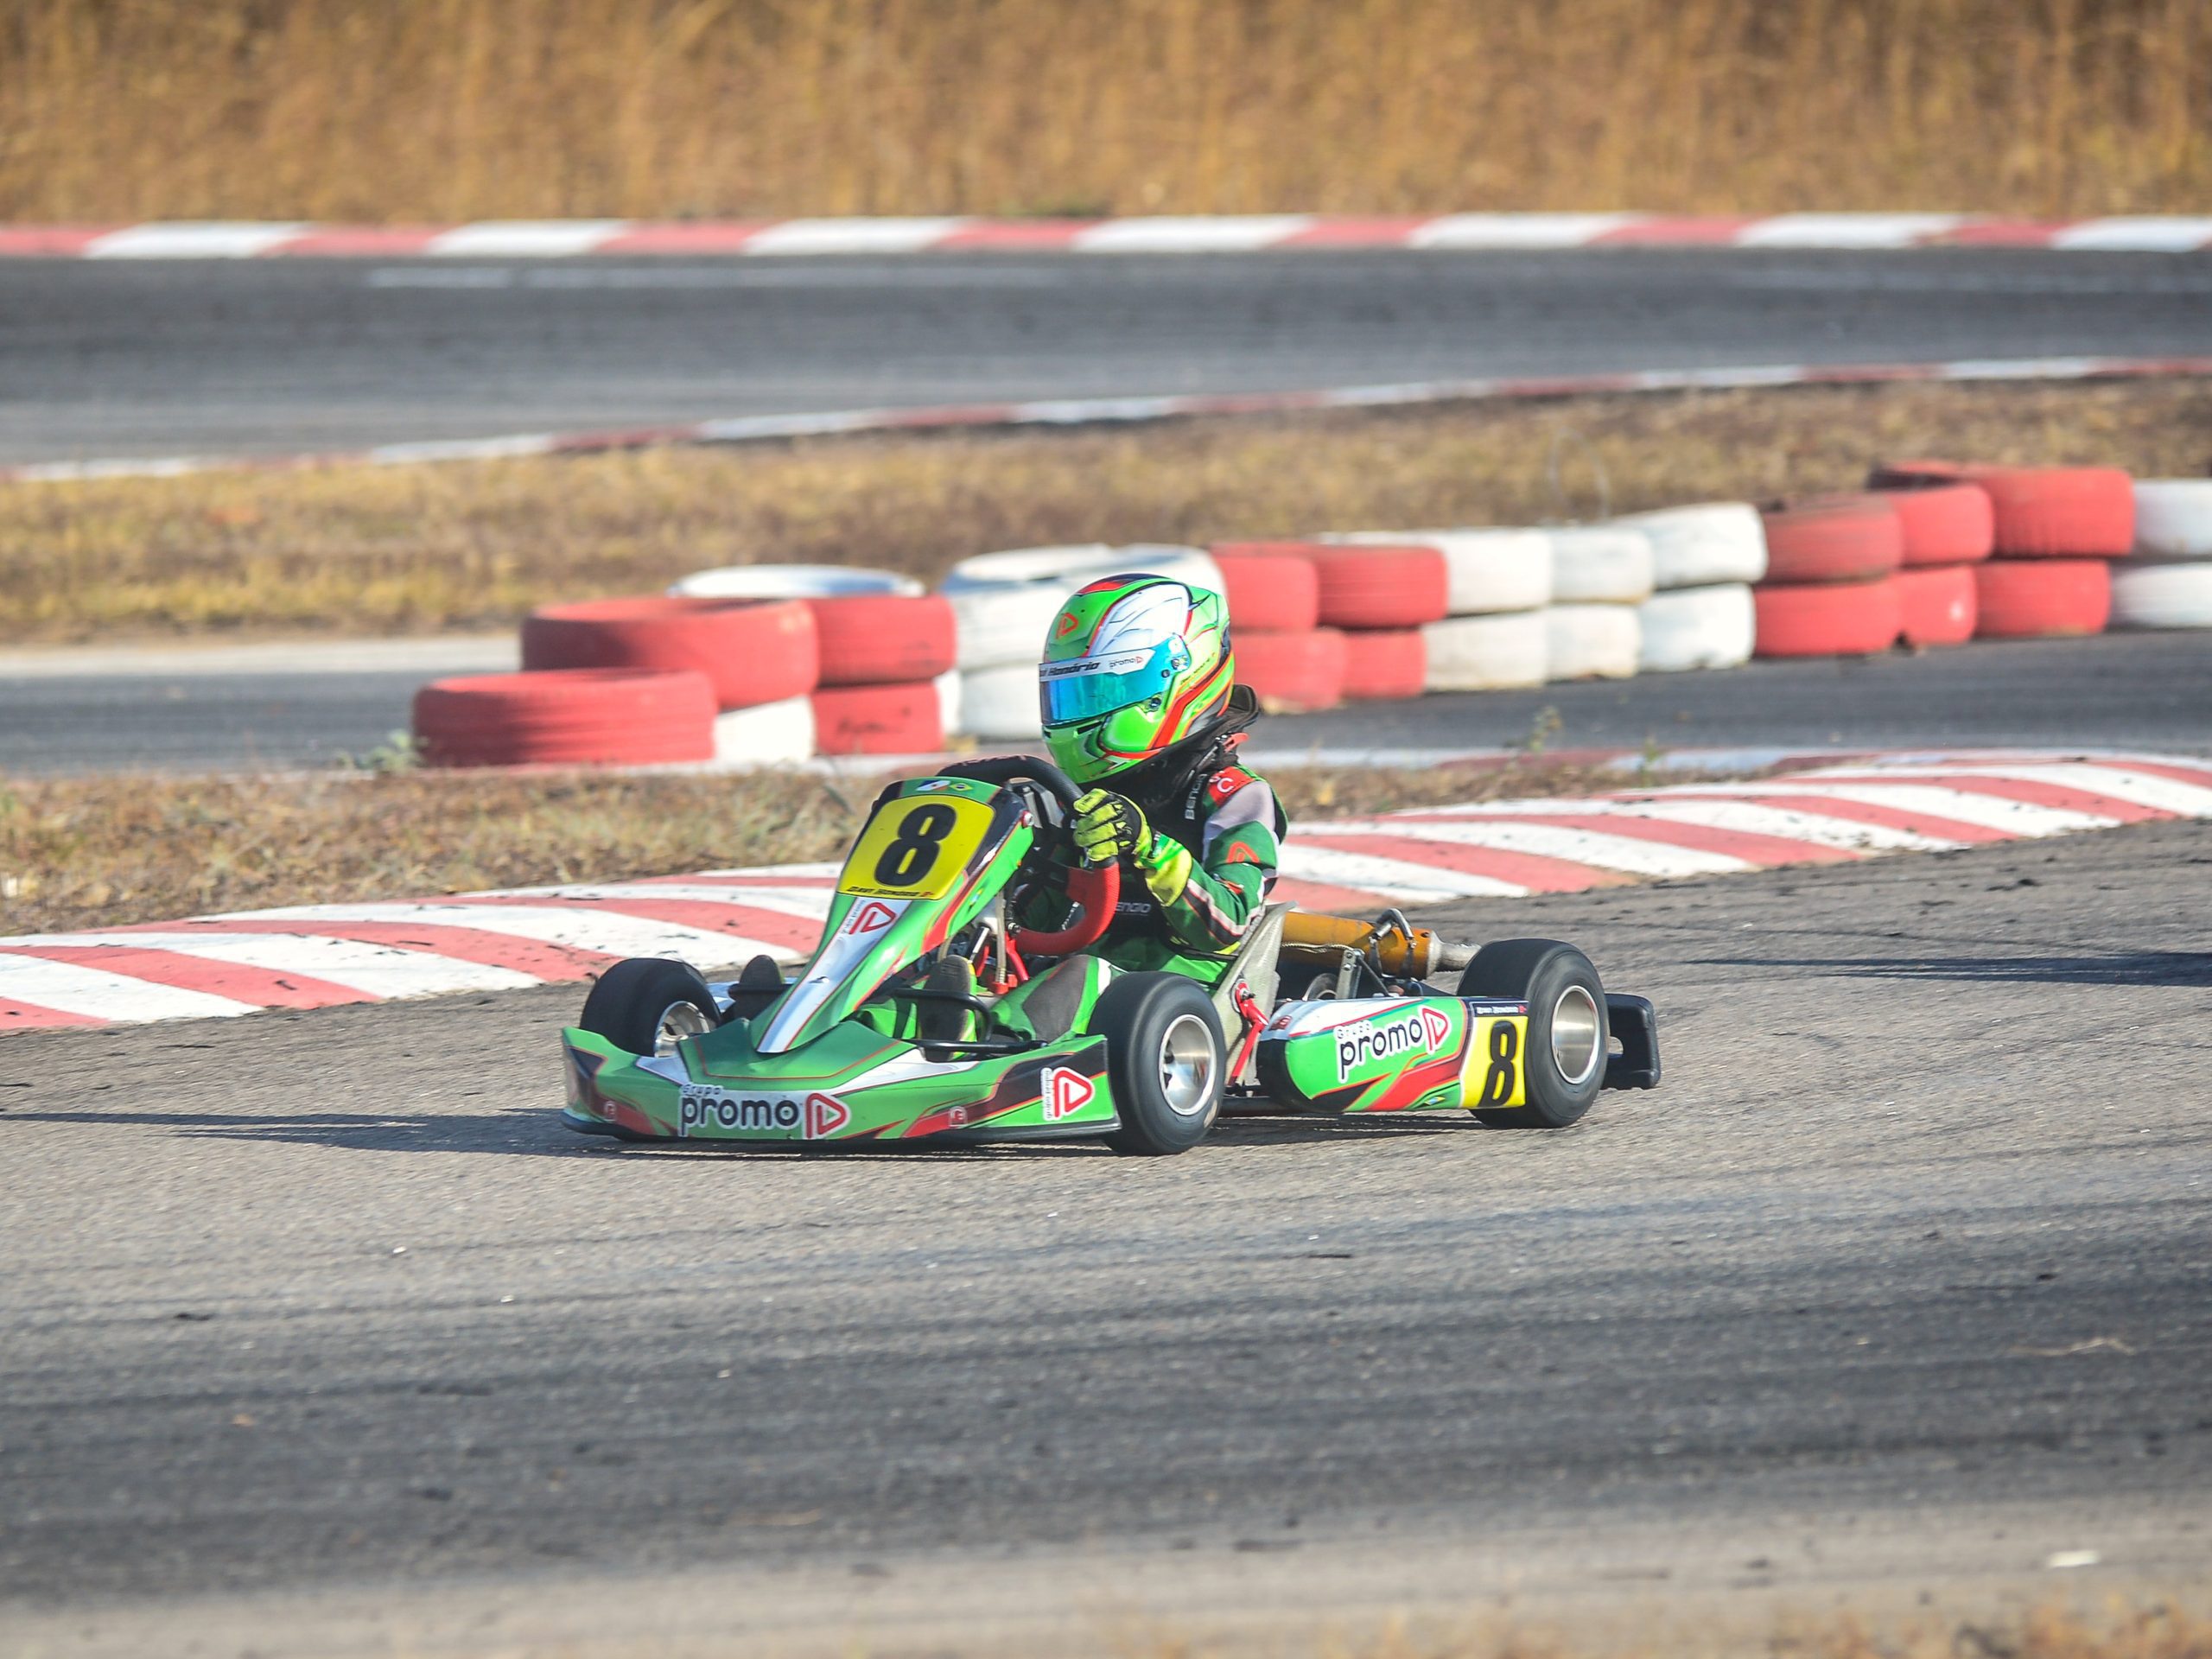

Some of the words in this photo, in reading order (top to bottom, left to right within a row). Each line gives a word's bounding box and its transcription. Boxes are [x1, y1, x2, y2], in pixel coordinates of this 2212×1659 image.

[874, 804, 957, 887] 8
[1339, 1018, 1423, 1080] promo
[1477, 1020, 1518, 1107] 8
[680, 1096, 799, 1137] promo
